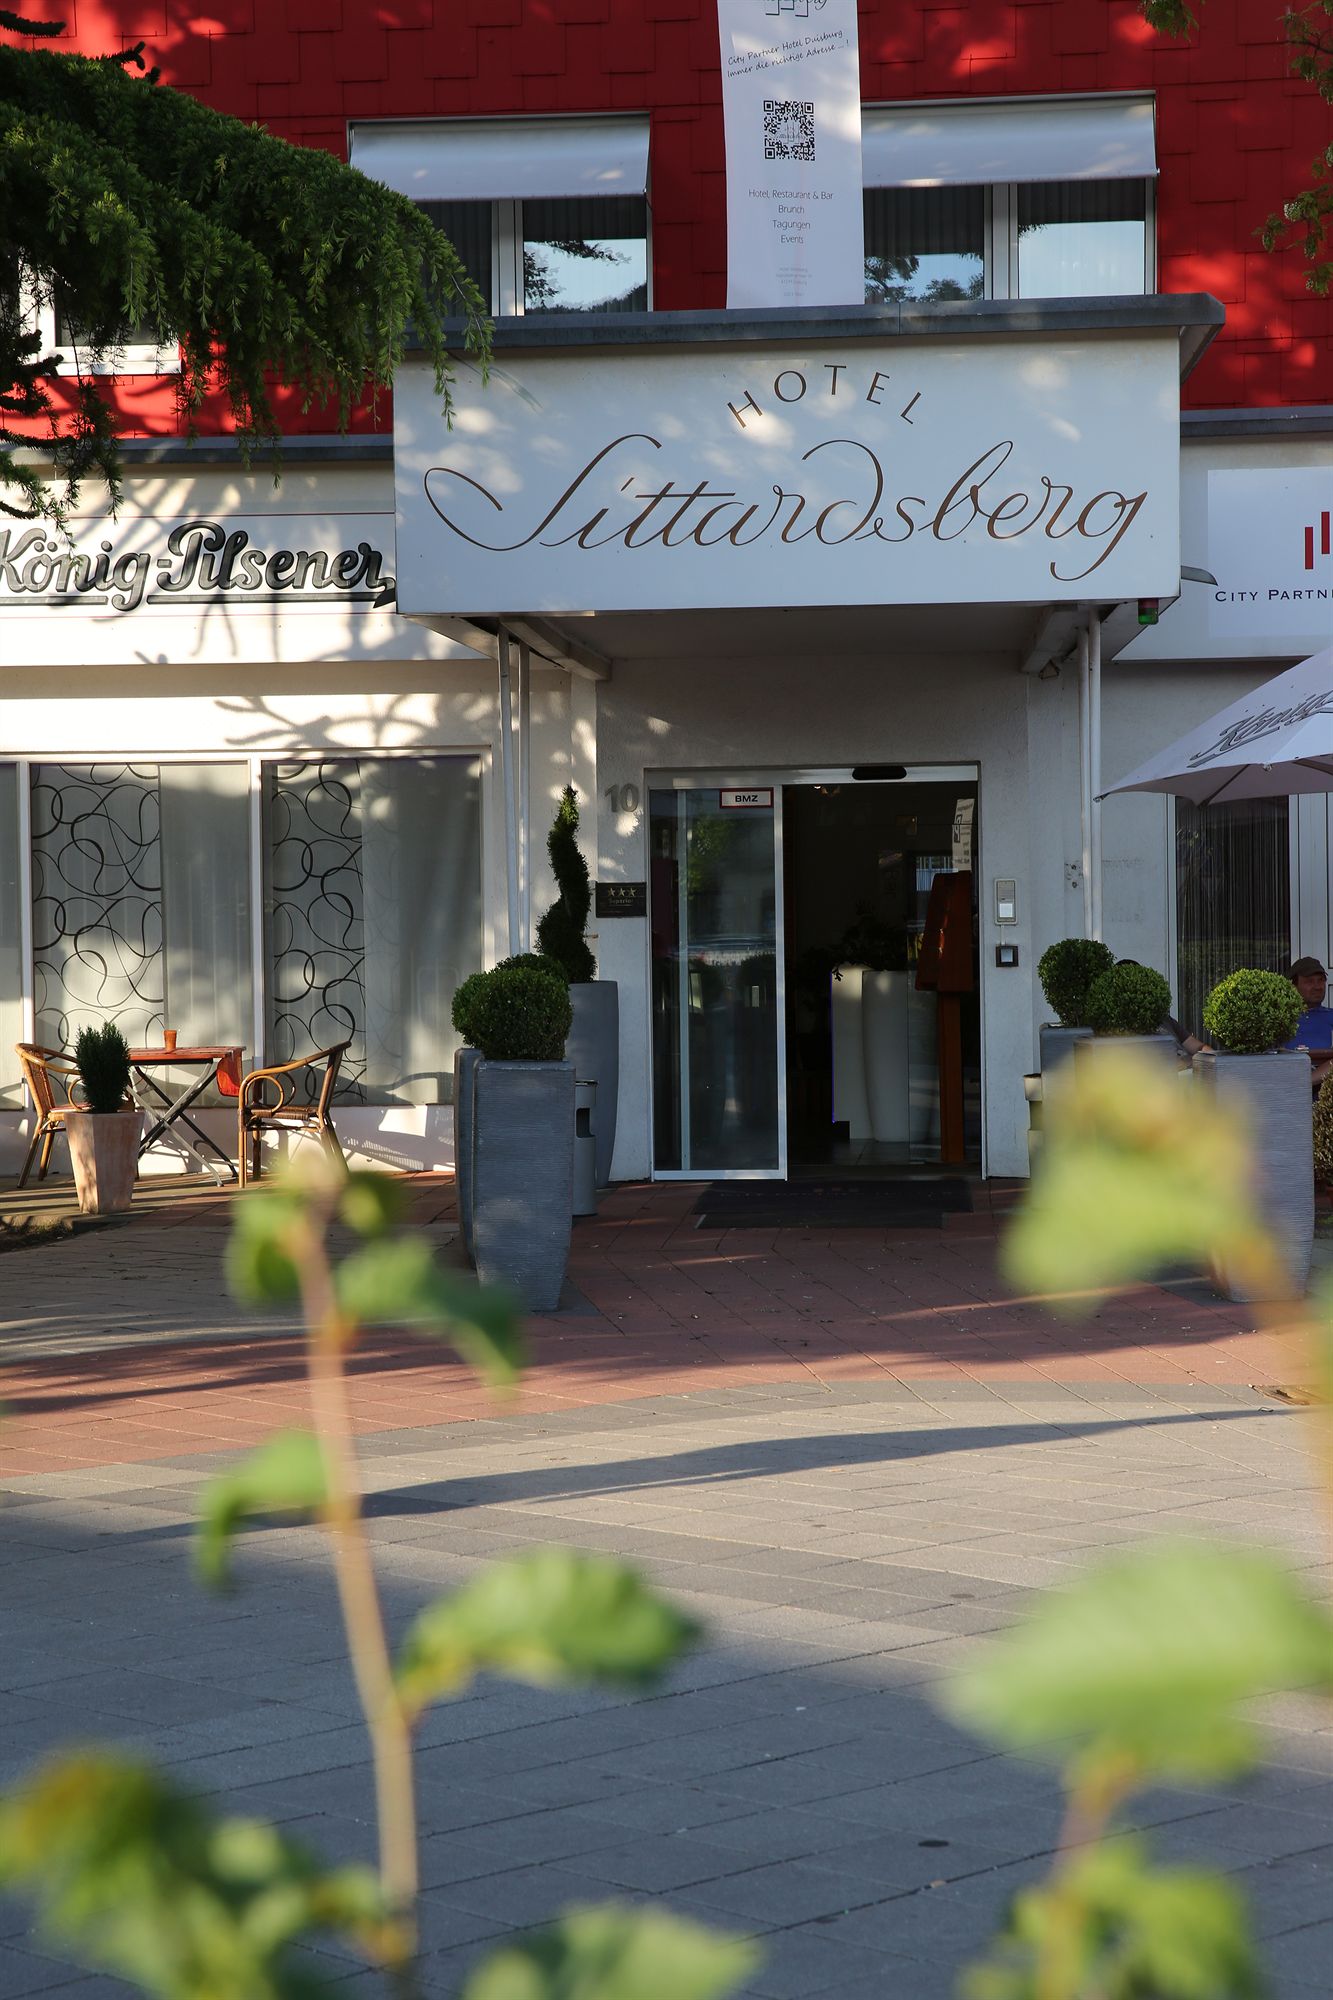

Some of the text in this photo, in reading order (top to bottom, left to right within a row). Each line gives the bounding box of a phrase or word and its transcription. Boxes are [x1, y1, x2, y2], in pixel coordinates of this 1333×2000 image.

[727, 30, 843, 66] City Partner Hotel Duisburg
[727, 66, 753, 78] Immer
[755, 60, 769, 71] die
[771, 52, 804, 66] richtige
[805, 45, 836, 58] Adresse
[772, 189, 811, 200] Restaurant
[812, 190, 819, 200] &
[820, 191, 834, 200] Bar
[778, 204, 805, 214] Brunch
[772, 219, 811, 231] Tagungen
[780, 234, 804, 244] Events
[727, 364, 922, 429] HOTEL
[423, 433, 1148, 582] Sittardsberg
[0, 520, 397, 612] König-Pilsener
[1215, 588, 1333, 602] CITY PARTN
[604, 783, 640, 813] 10
[735, 794, 759, 803] BMZ
